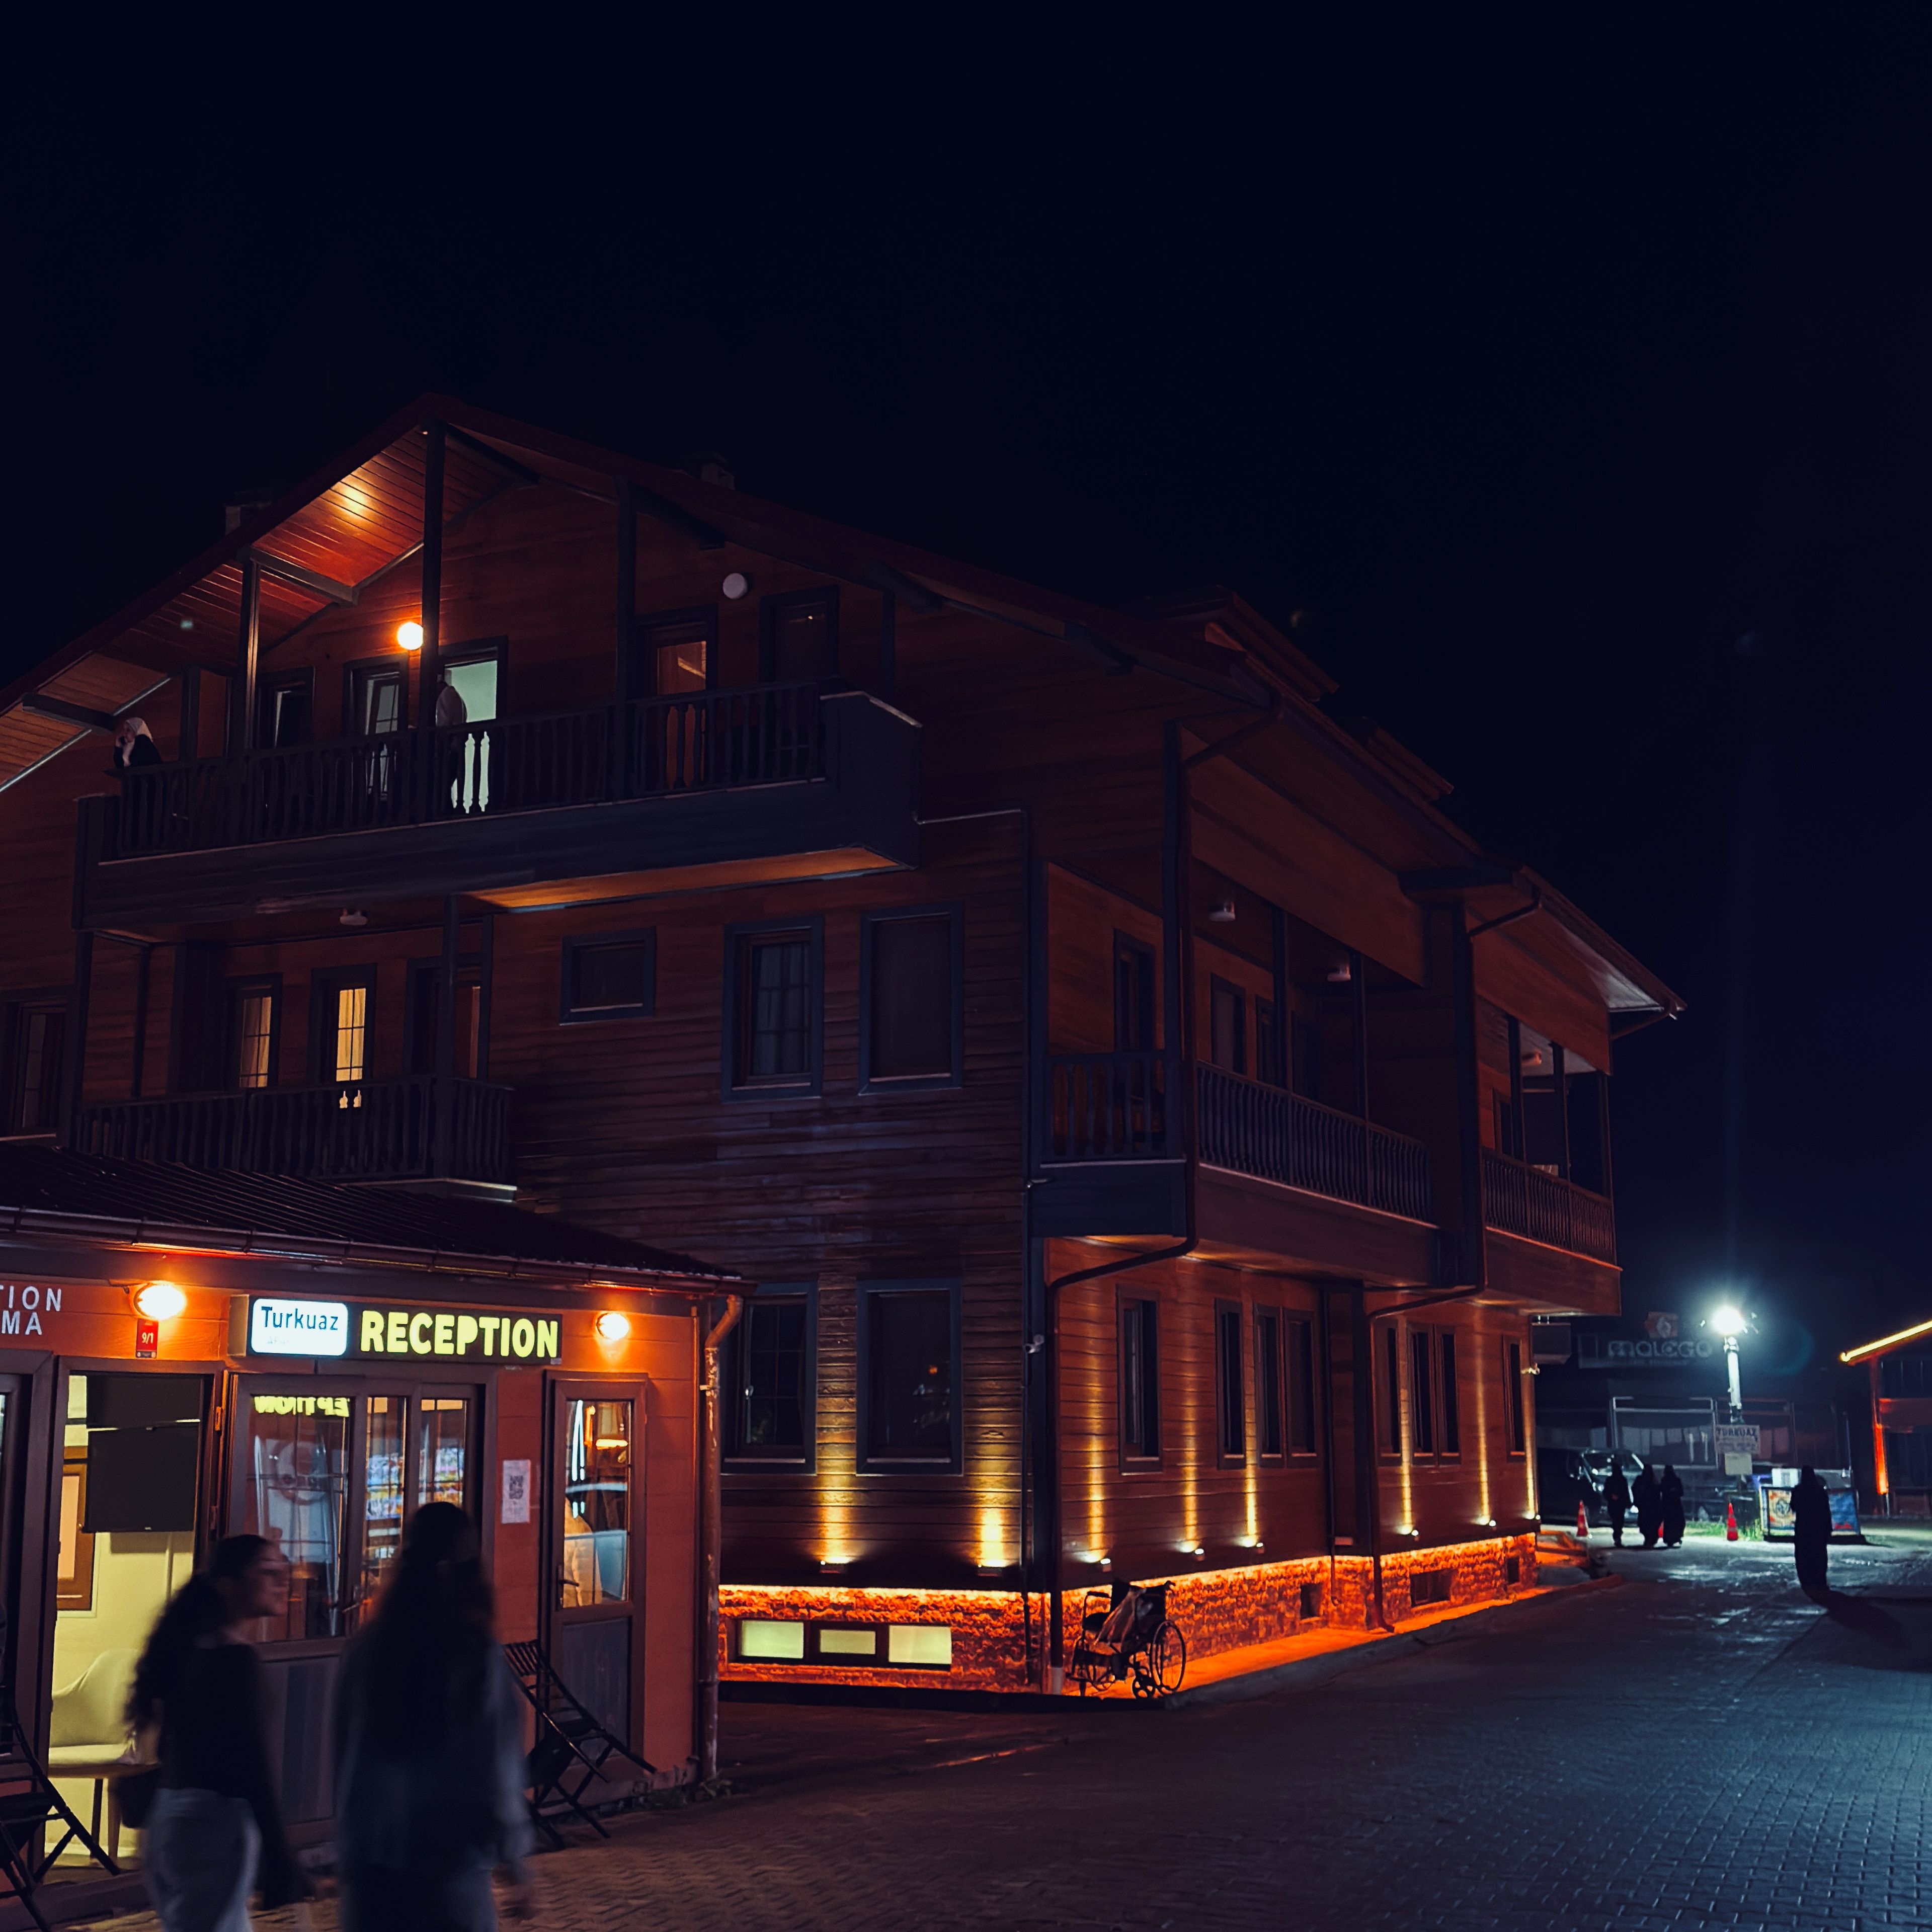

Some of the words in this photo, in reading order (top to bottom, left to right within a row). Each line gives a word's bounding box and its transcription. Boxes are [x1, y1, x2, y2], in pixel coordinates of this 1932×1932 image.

[2, 1310, 42, 1335] MA
[261, 1305, 339, 1331] Turkuaz
[141, 1332, 154, 1344] 9/1
[361, 1310, 558, 1358] RECEPTION
